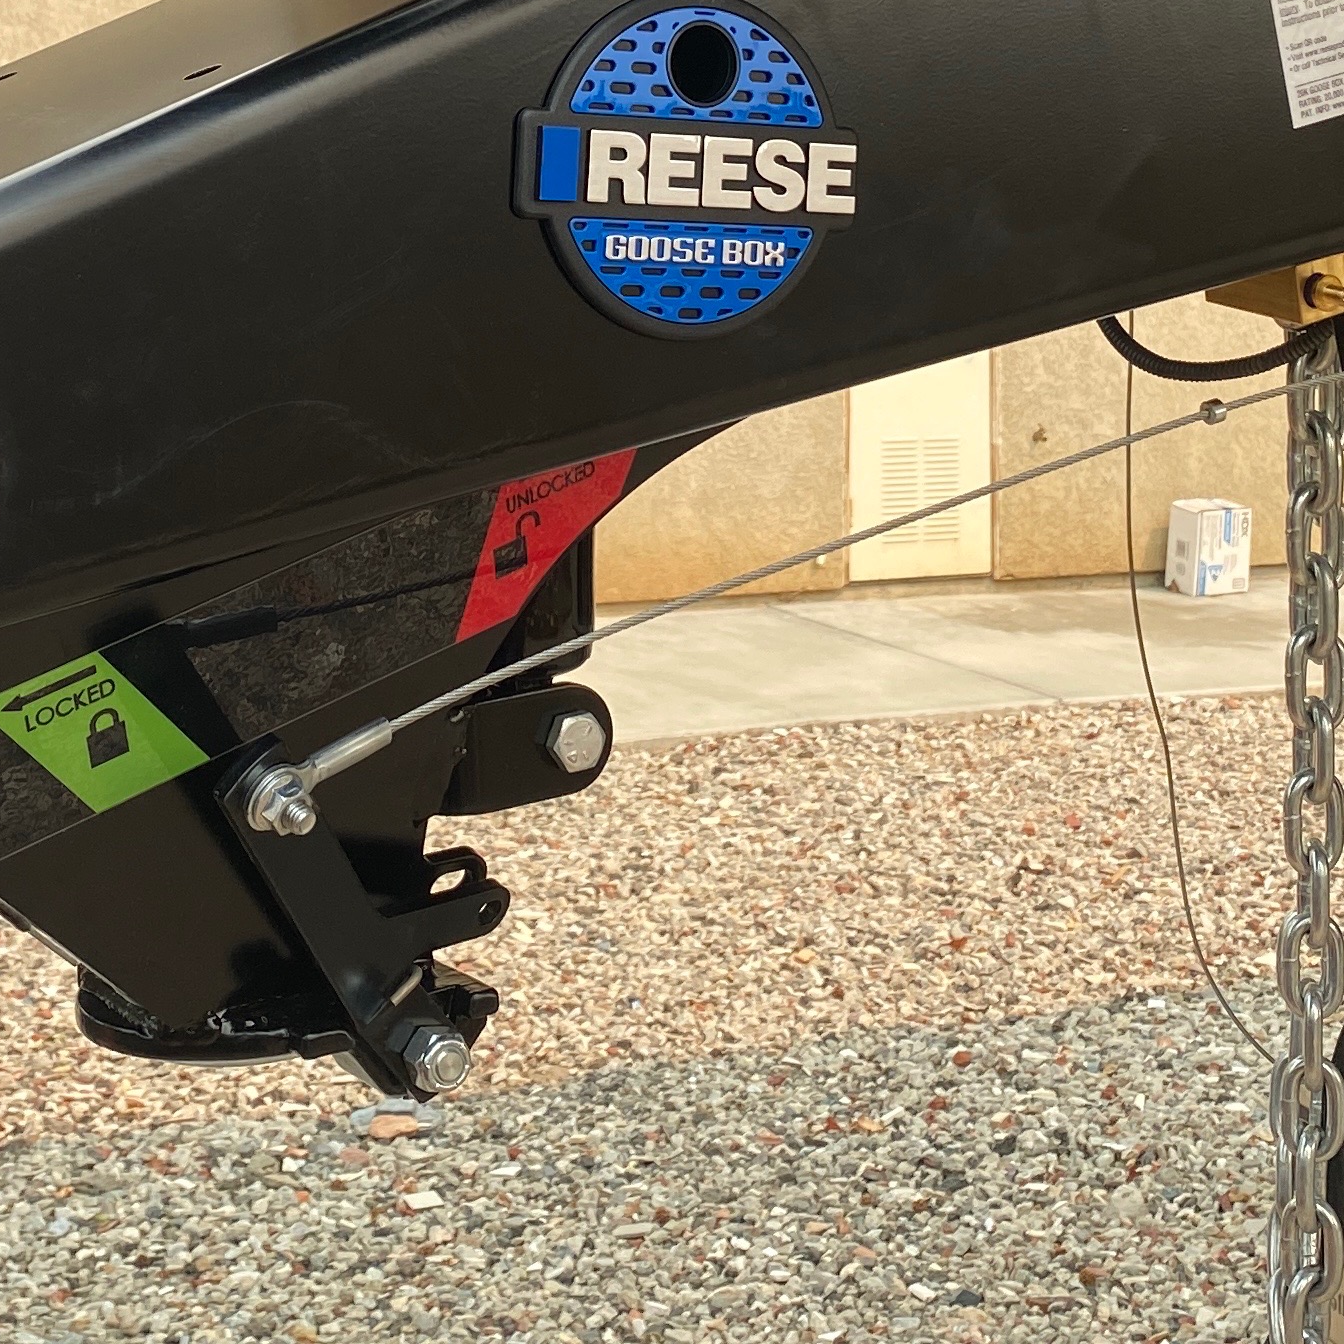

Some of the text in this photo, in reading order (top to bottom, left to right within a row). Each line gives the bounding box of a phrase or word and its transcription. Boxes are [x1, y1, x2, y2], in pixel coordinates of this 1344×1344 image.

[586, 129, 856, 215] REESE
[605, 235, 785, 267] GOOSE BOX
[506, 461, 596, 514] UNLOCKED
[23, 678, 116, 733] LOCKED
